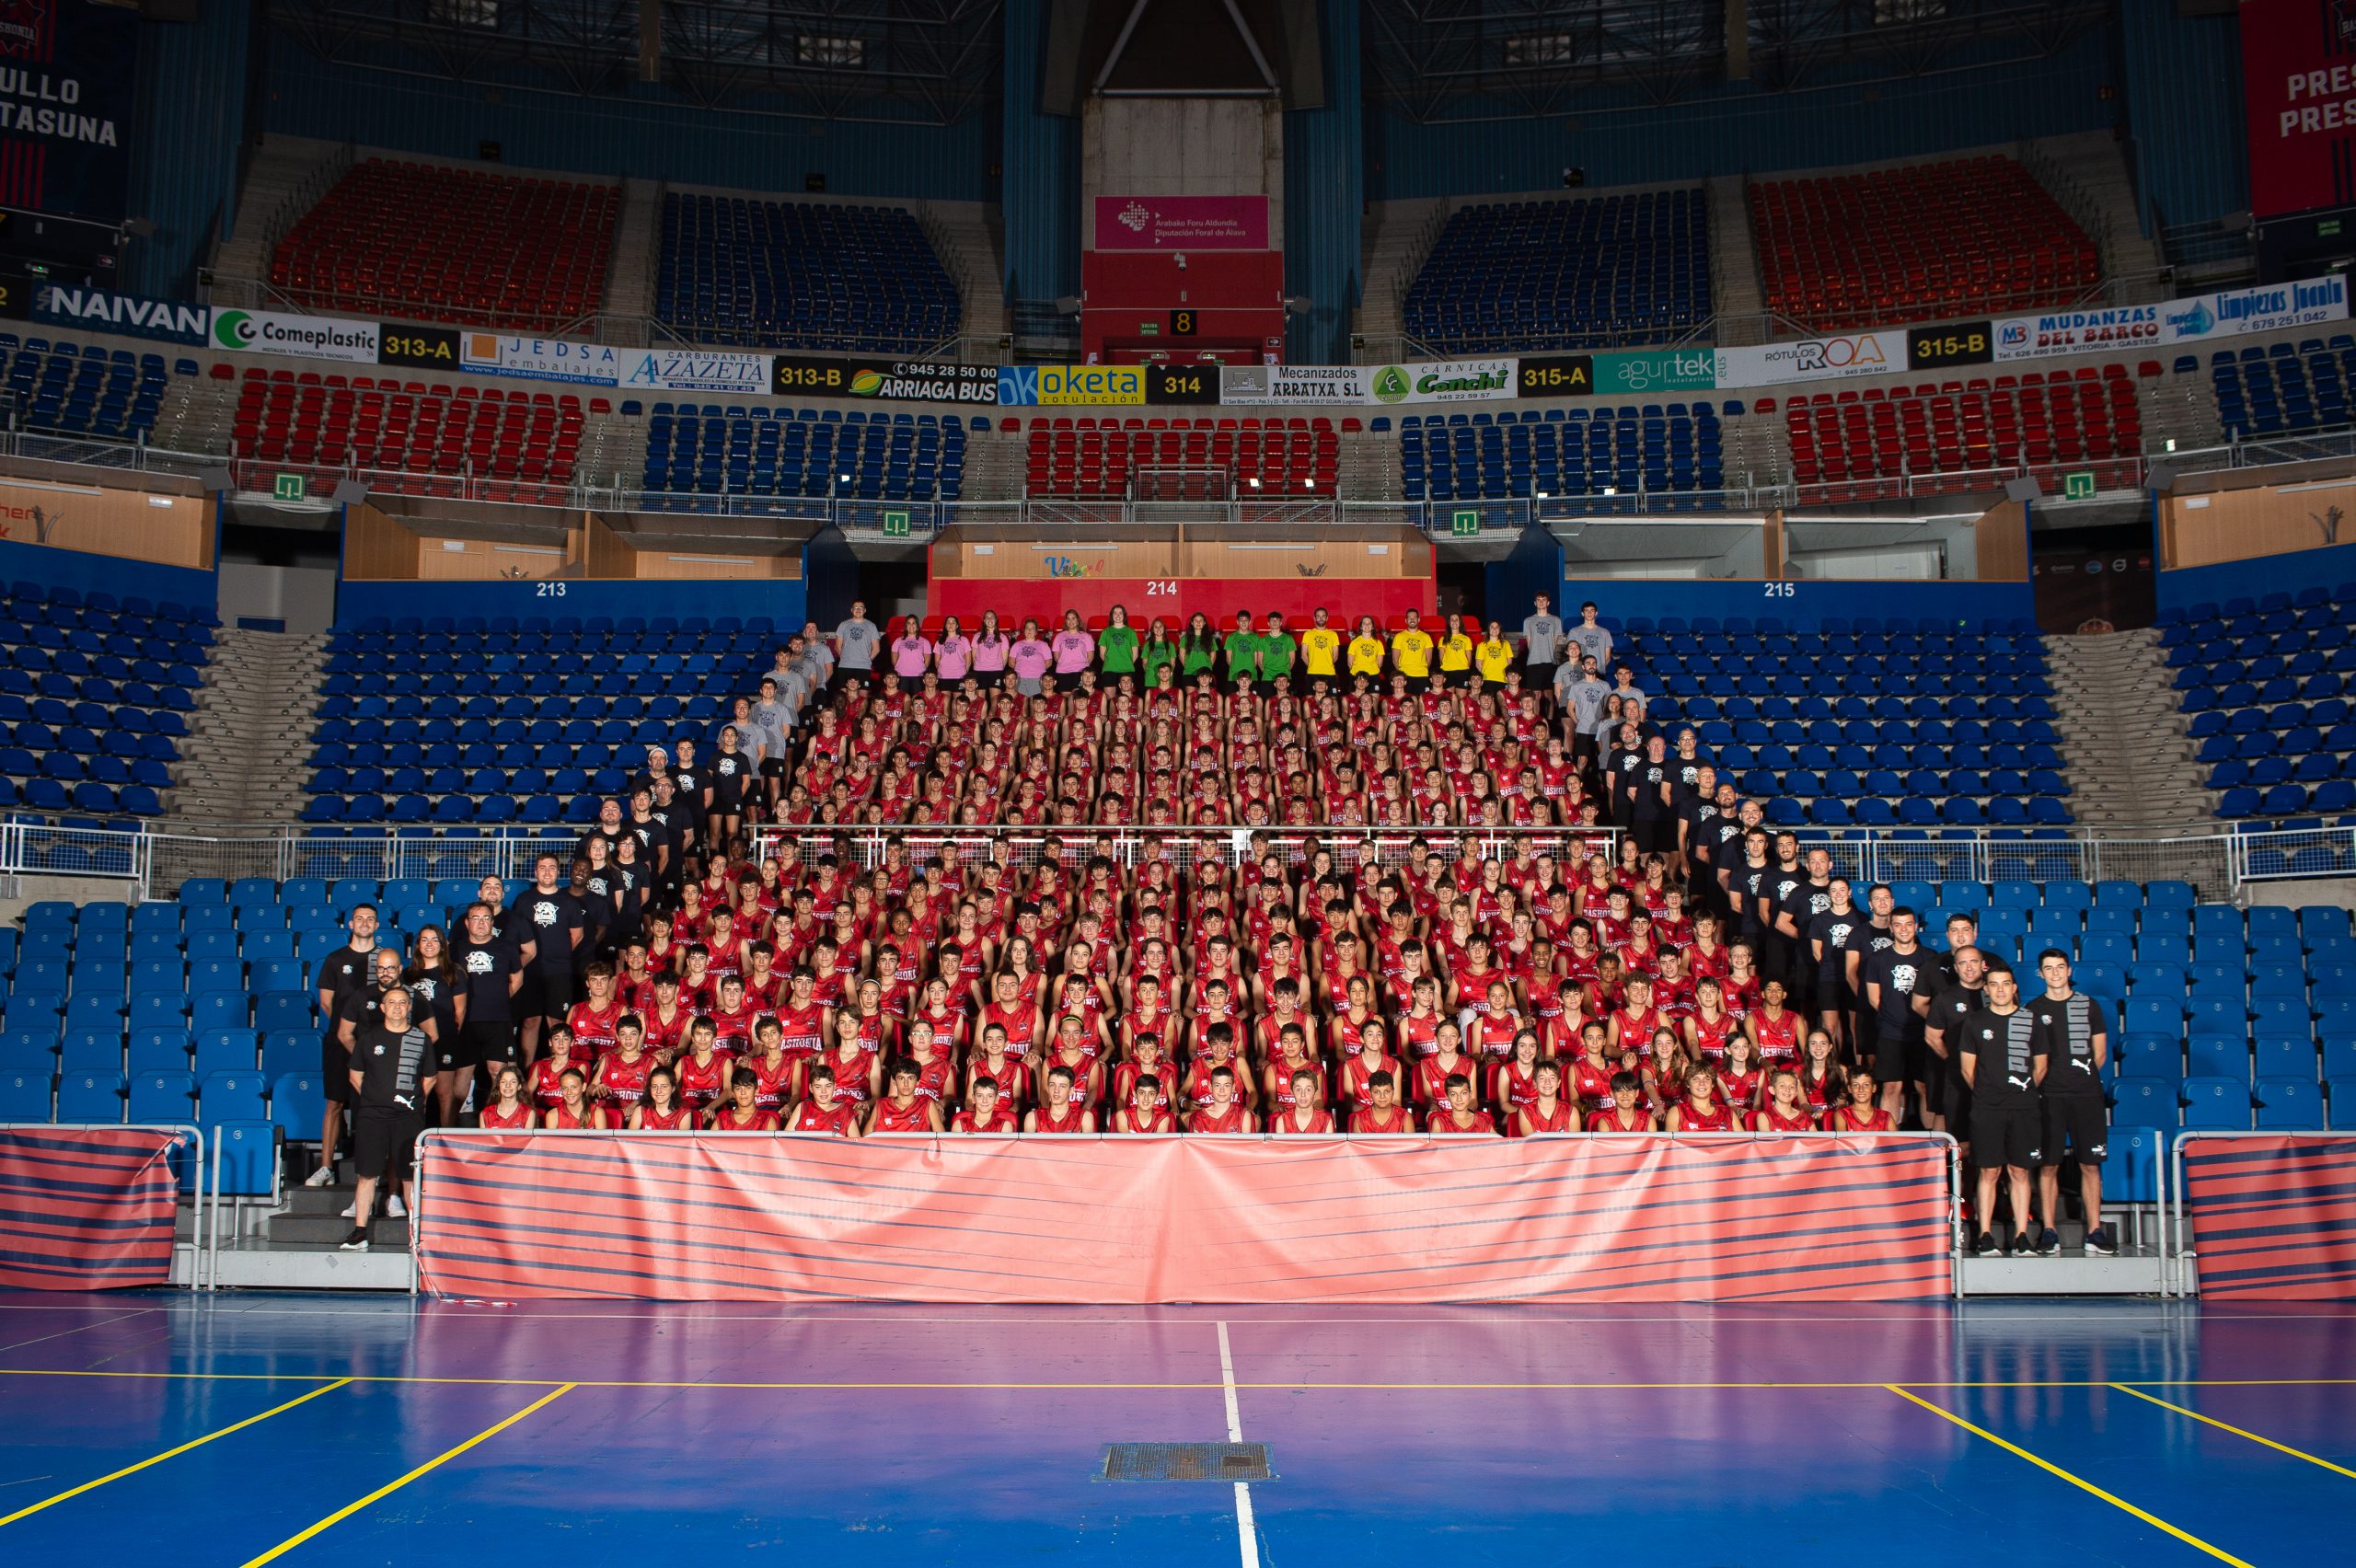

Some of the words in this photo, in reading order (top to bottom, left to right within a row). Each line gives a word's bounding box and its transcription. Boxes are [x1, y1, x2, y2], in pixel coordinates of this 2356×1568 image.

[0, 66, 79, 105] ULLO
[0, 101, 117, 147] TASUNA
[1155, 229, 1194, 237] Diputación
[51, 287, 207, 336] NAIVAN
[2217, 290, 2285, 320] Limpiezas
[1177, 313, 1190, 332] 8
[2039, 306, 2156, 331] MUDANZAS
[2279, 316, 2300, 326] 251
[263, 321, 375, 349] Comeplastic
[1917, 333, 1985, 359] 315-B
[2038, 331, 2075, 348] DEL
[2085, 323, 2159, 343] BARCO
[2073, 342, 2110, 352] VITORIA
[2119, 337, 2160, 348] GASTEIZ
[385, 336, 452, 359] 313-A
[510, 339, 615, 362] JEDSA
[668, 352, 761, 363] CARBURANTES
[1765, 348, 1816, 362] RÓTULOS
[1797, 335, 1885, 371] ROA
[464, 364, 614, 386] www.jedsaembalajes.com
[510, 358, 615, 376] embalajes
[780, 367, 841, 386] 313-B
[909, 364, 934, 375] 945
[939, 365, 955, 376] 28
[960, 366, 976, 377] 50
[981, 368, 997, 378] 00
[1279, 367, 1357, 378] Mecanizados
[1421, 362, 1507, 374] CÁRNICAS
[1524, 367, 1586, 386] 315-A
[1618, 352, 1714, 389] agurtek
[879, 379, 958, 400] ARRIAGA
[959, 382, 997, 401] BUS
[1044, 367, 1138, 394] oketa
[1165, 376, 1201, 394] 314
[1273, 382, 1339, 397] ARRATXA,
[1344, 382, 1364, 397] S.L.
[1416, 370, 1508, 394] Conchi
[1044, 394, 1138, 403] rotulación
[537, 582, 566, 596] 213
[1147, 582, 1177, 595] 214
[1764, 582, 1795, 596] 215
[2067, 992, 2090, 1055] PUMA
[2008, 1007, 2033, 1073] PUMA
[396, 1026, 425, 1090] PUMA
